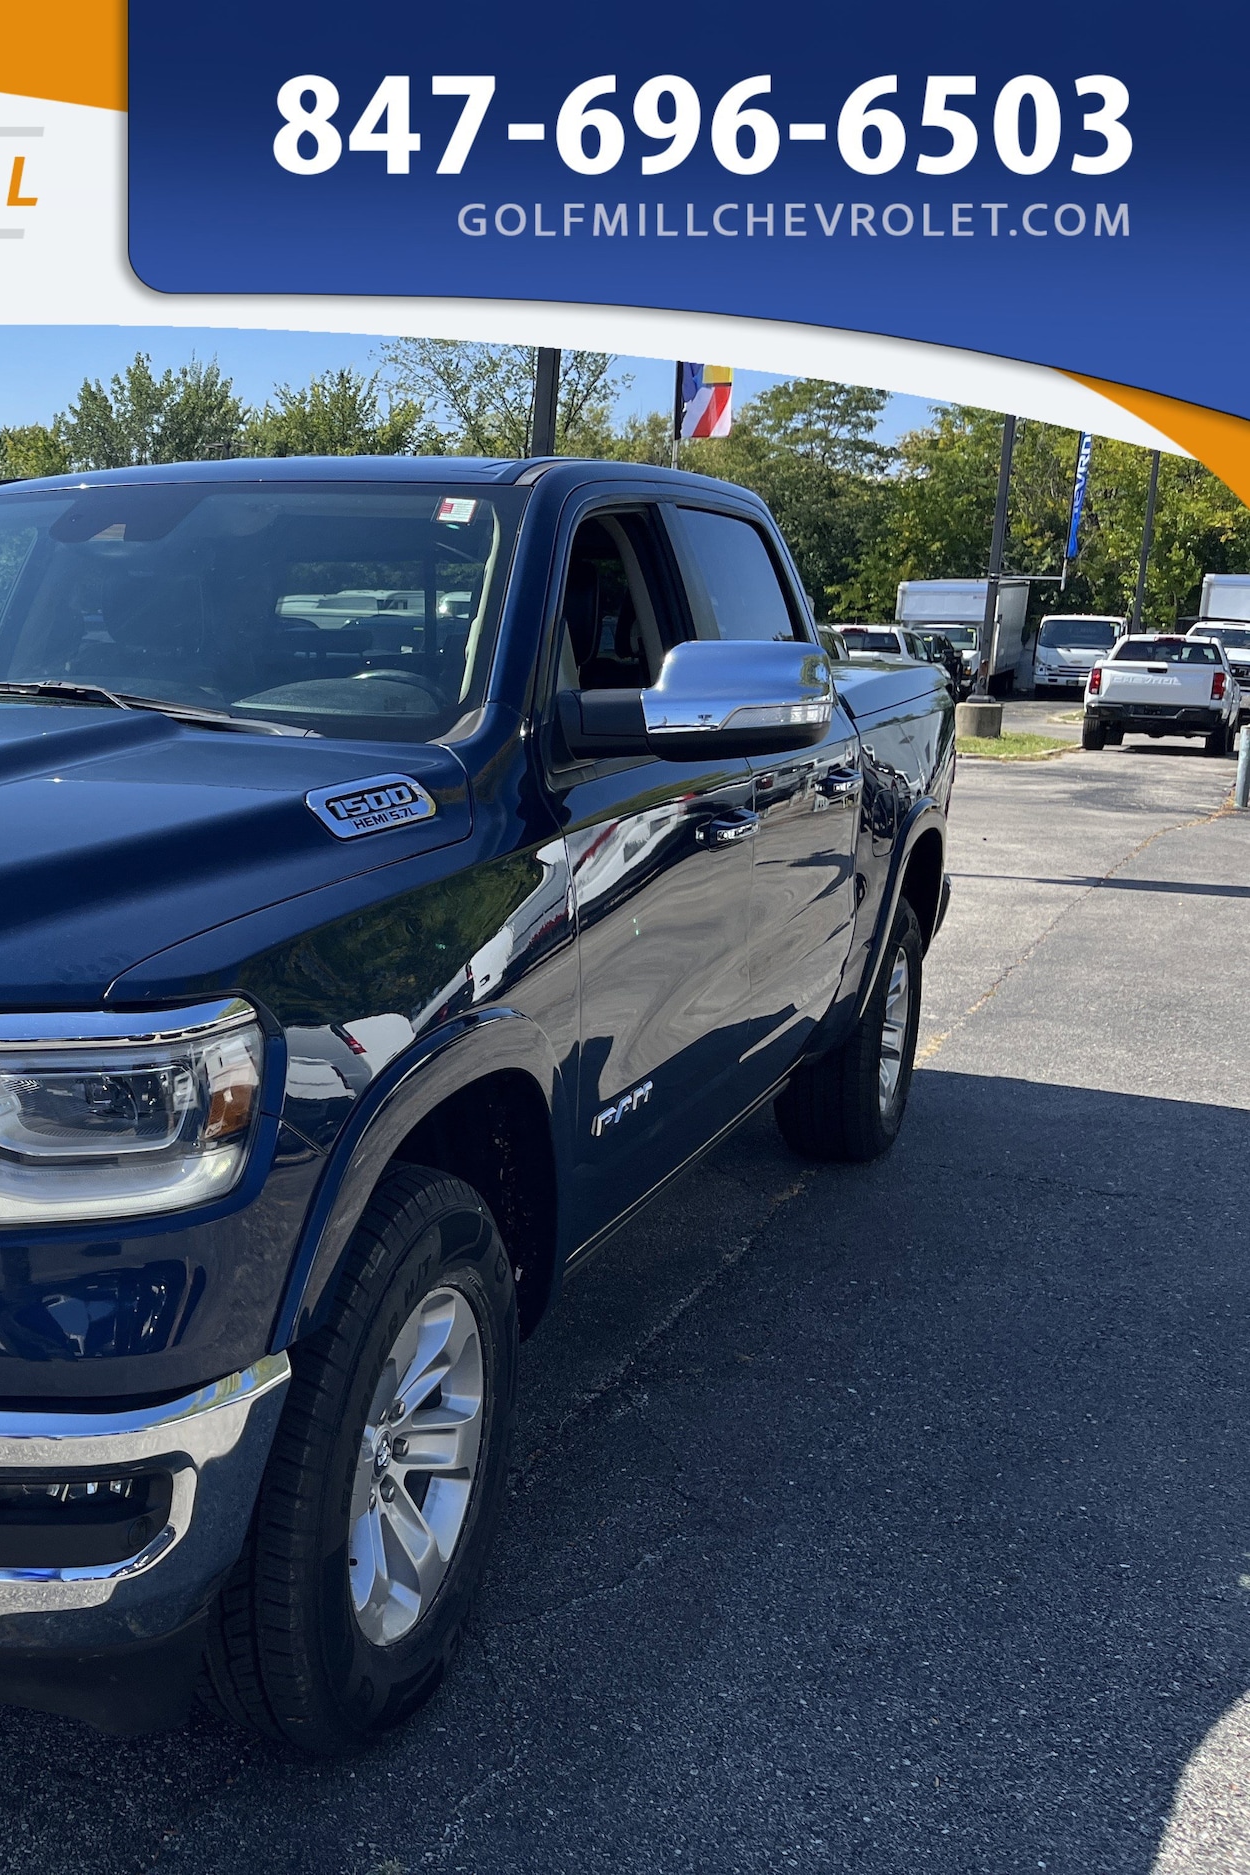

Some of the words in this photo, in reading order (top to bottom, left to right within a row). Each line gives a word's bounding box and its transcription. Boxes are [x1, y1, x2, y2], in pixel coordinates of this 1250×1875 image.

[329, 787, 412, 818] 1500
[353, 813, 388, 830] HEMI
[391, 808, 419, 821] 5.7L
